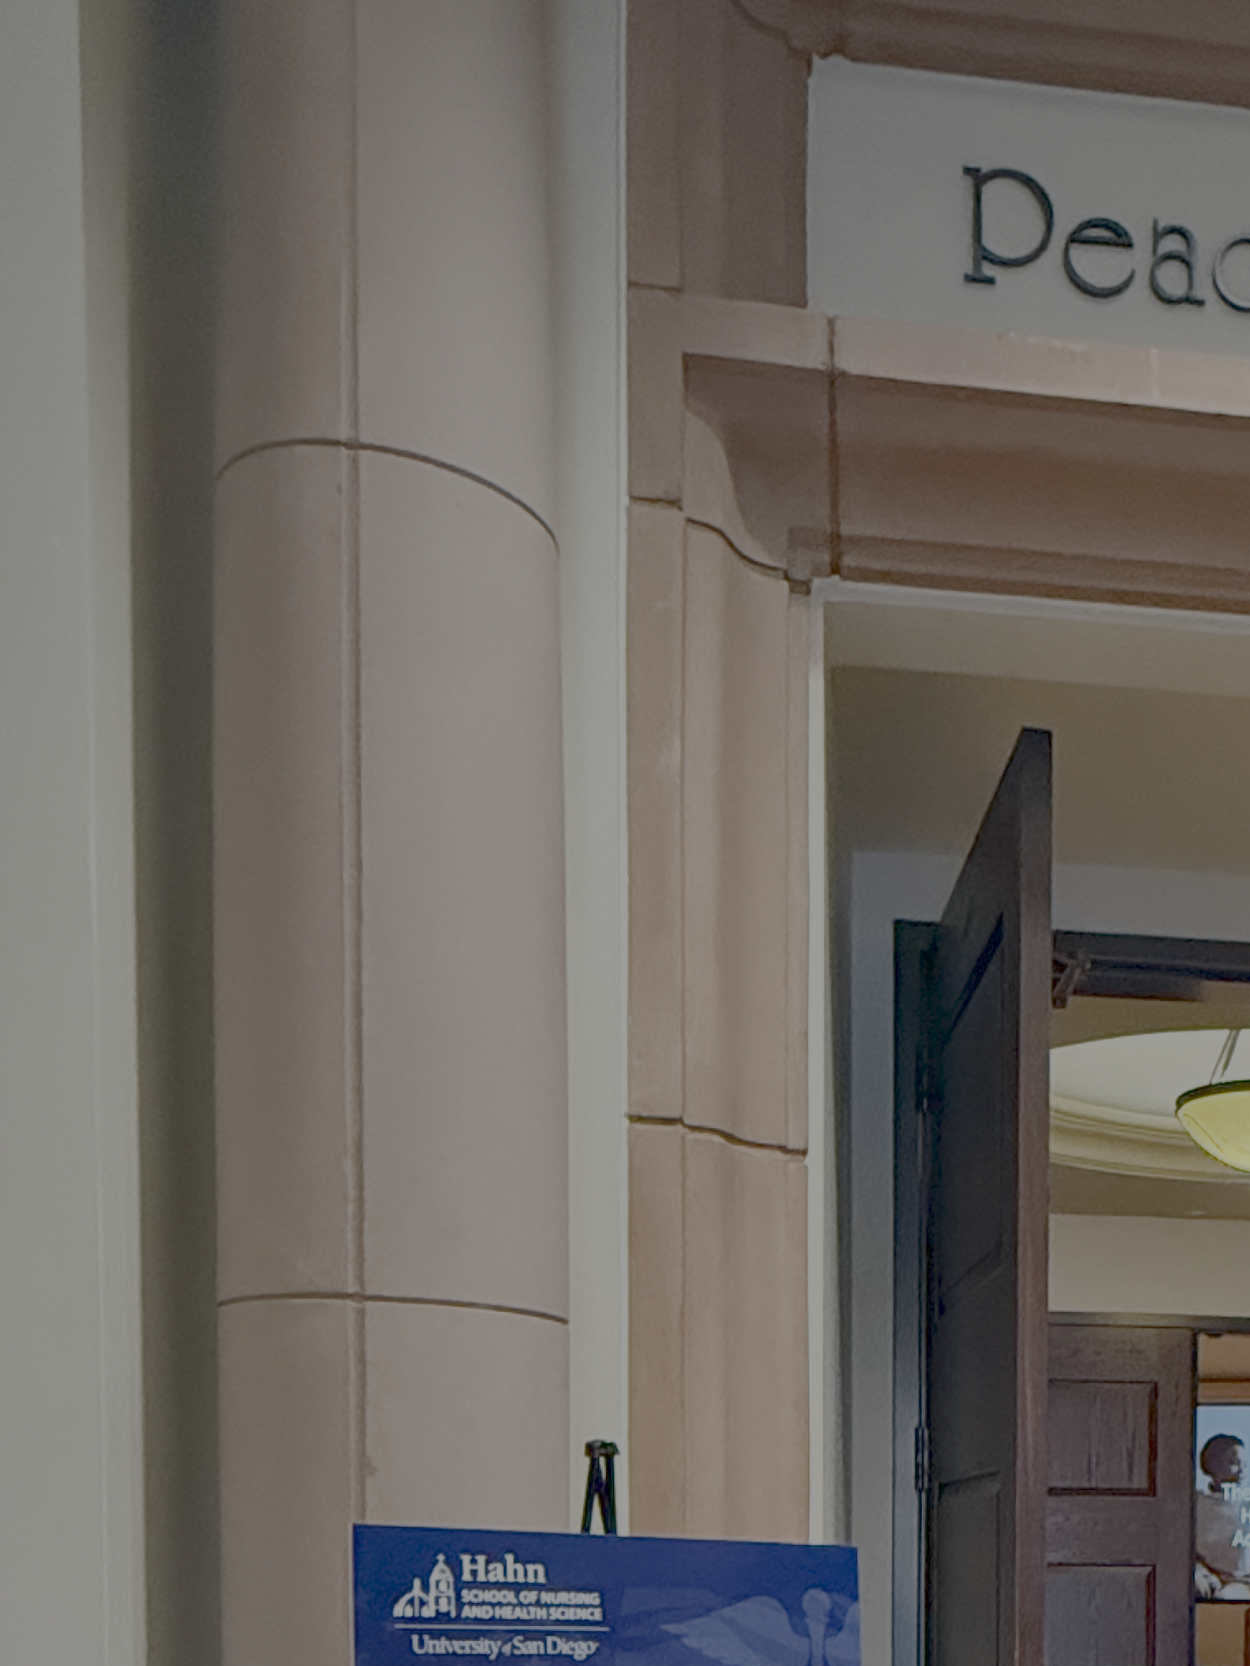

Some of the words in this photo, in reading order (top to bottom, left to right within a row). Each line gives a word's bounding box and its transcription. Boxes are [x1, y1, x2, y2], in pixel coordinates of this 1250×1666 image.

[460, 1553, 547, 1584] Hahn
[461, 1589, 518, 1604] SCHOOL
[519, 1590, 539, 1605] OF
[540, 1591, 601, 1606] NURSING
[461, 1604, 494, 1619] AND
[495, 1606, 548, 1620] HEALTH
[549, 1607, 603, 1621] SCIENCE
[411, 1634, 502, 1661] University
[512, 1635, 545, 1655] San
[546, 1635, 600, 1661] Diego
